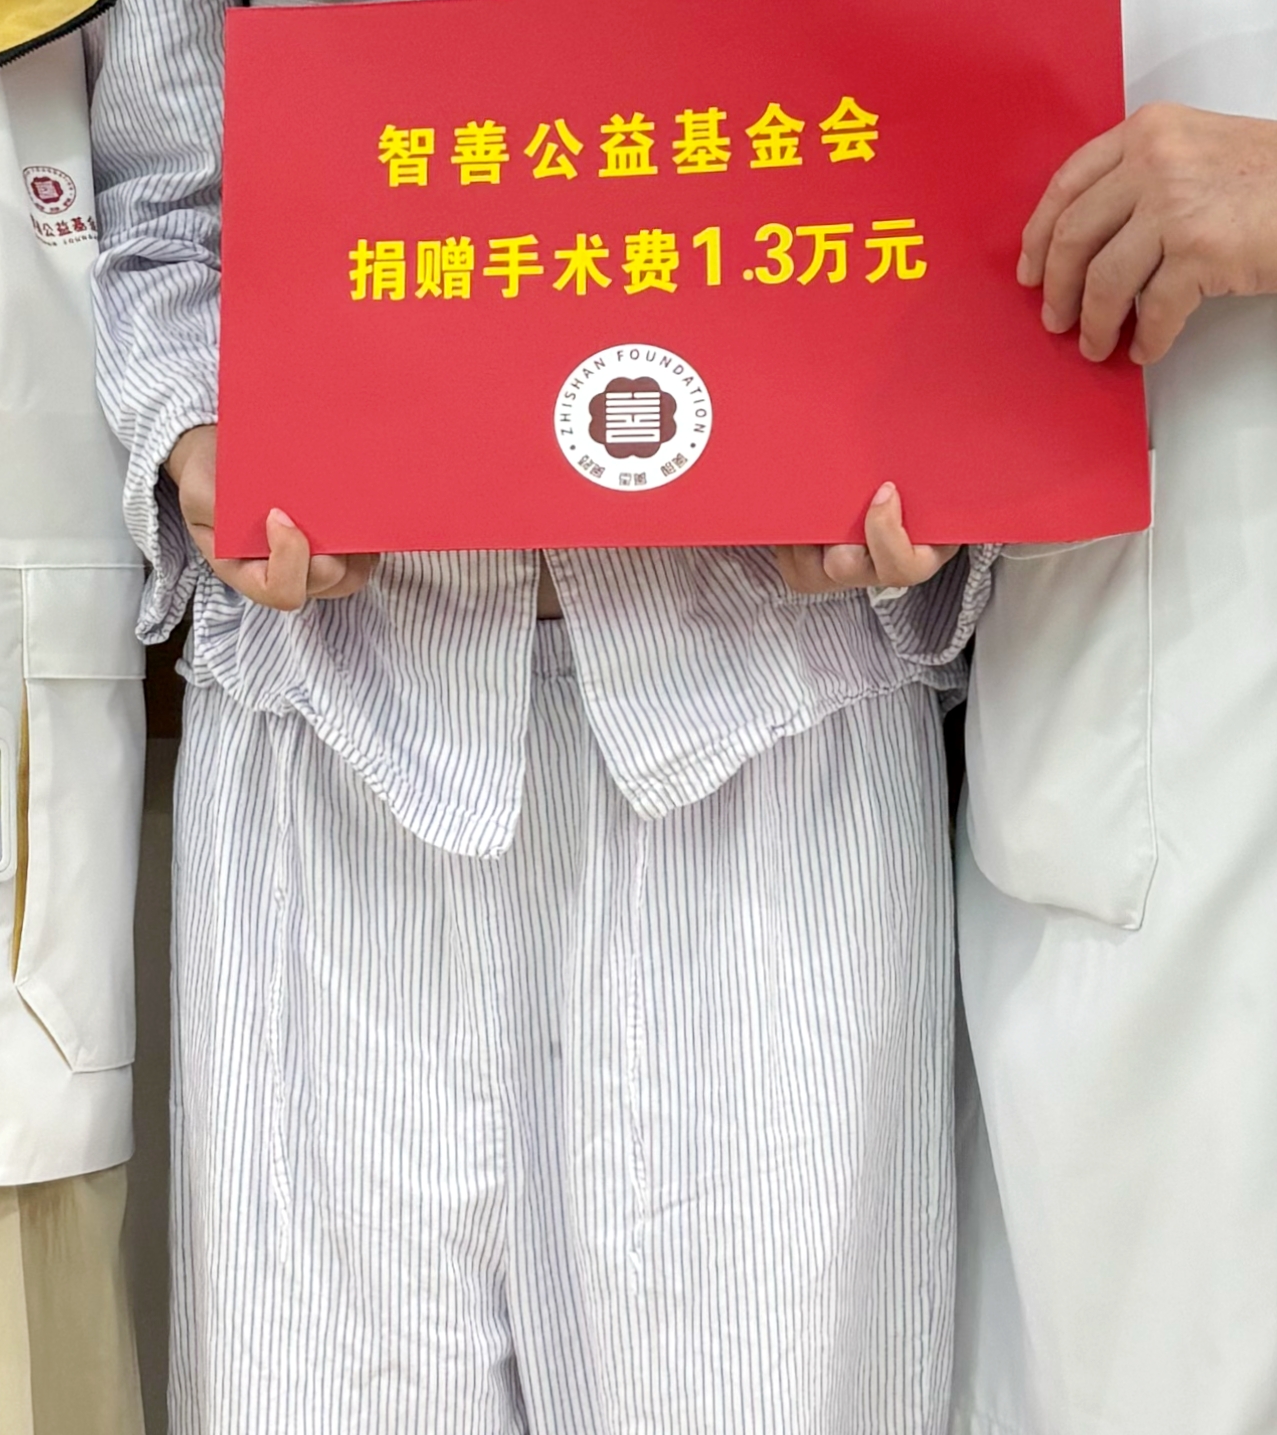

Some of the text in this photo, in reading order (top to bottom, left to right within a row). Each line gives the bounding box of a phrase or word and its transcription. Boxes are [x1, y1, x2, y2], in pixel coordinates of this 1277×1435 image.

[378, 96, 880, 188] 智善公益基金会
[348, 218, 928, 302] 捐赠手术费1.3万元
[560, 348, 708, 436] ZHISHAN FOUNDATION
